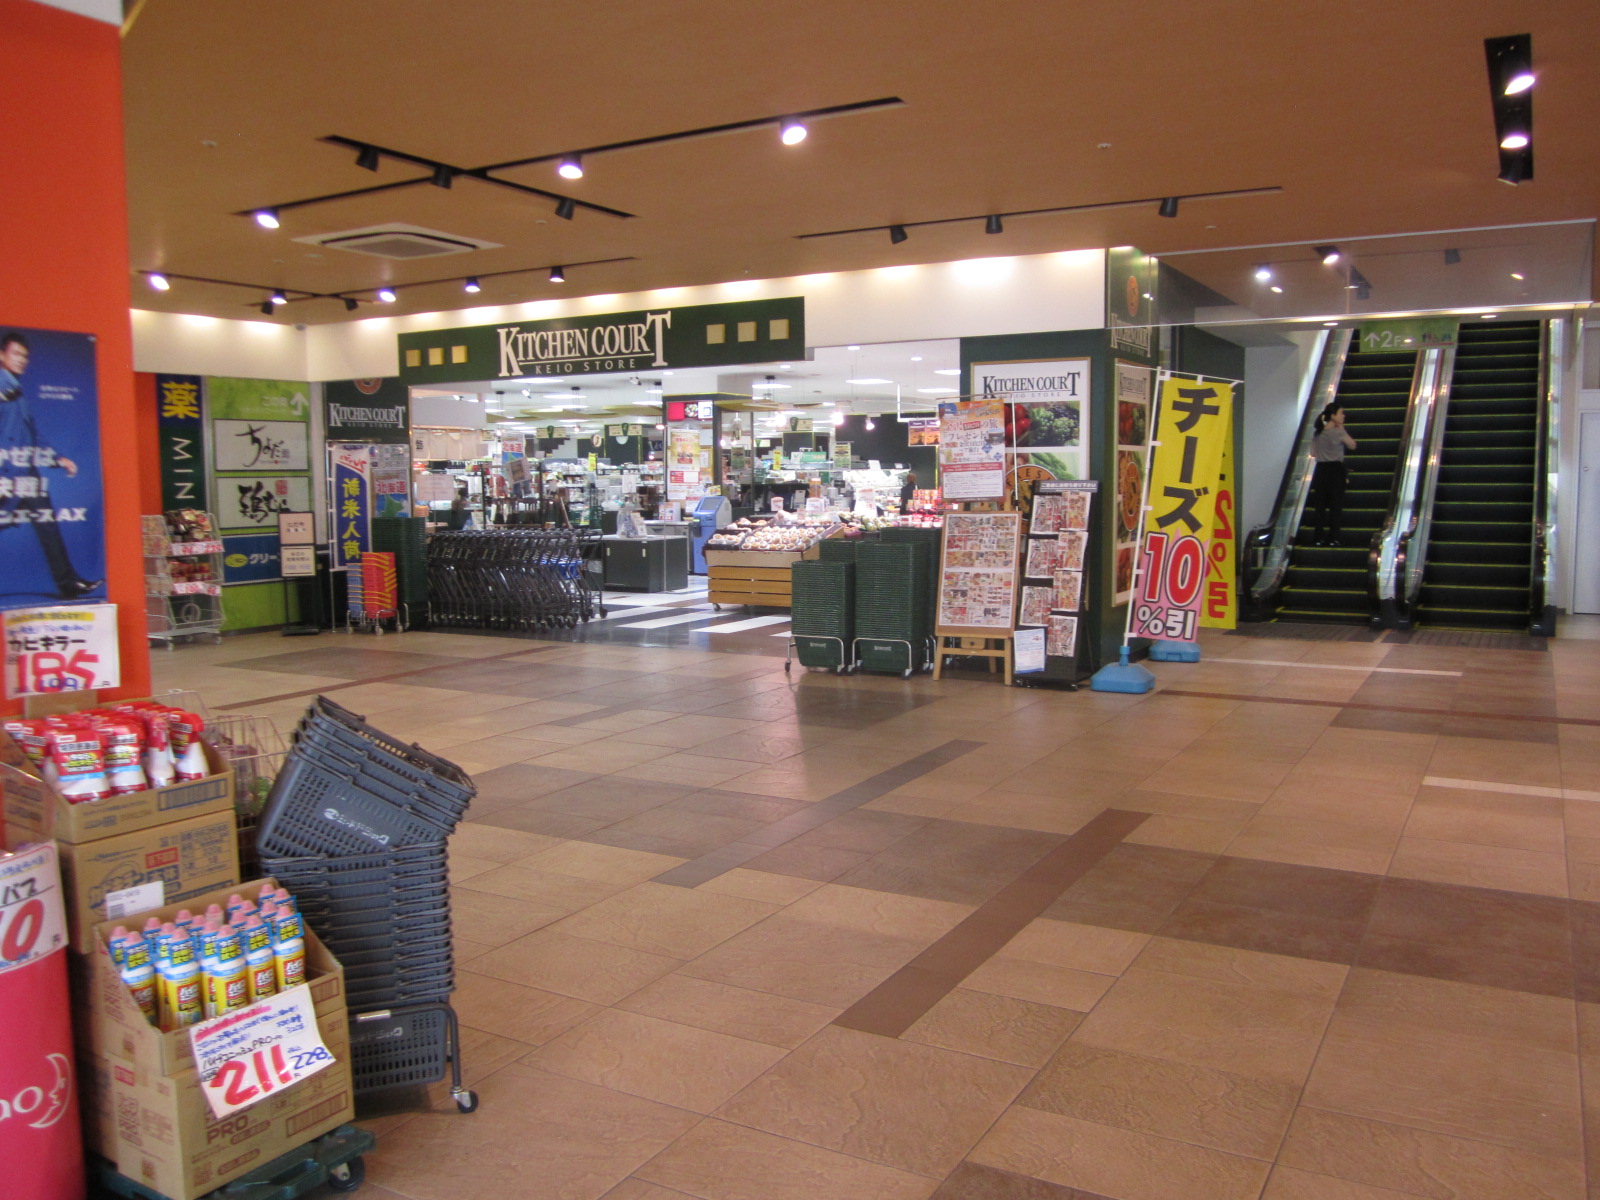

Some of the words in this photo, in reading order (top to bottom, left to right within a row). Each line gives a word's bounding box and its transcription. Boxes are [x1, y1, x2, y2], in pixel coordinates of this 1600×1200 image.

[497, 327, 589, 377] KITCHEN
[592, 310, 672, 366] COURT
[535, 362, 573, 375] KEIO
[583, 358, 636, 372] STORE
[982, 375, 1035, 399] KITCHEN
[1036, 371, 1081, 396] COURT
[161, 381, 200, 419] 薬
[328, 403, 372, 427] KITCHEN
[373, 405, 406, 428] COURT
[1156, 387, 1220, 534] チーズ
[1144, 531, 1204, 607] 10
[16, 649, 100, 693] 185
[289, 1047, 328, 1070] 228
